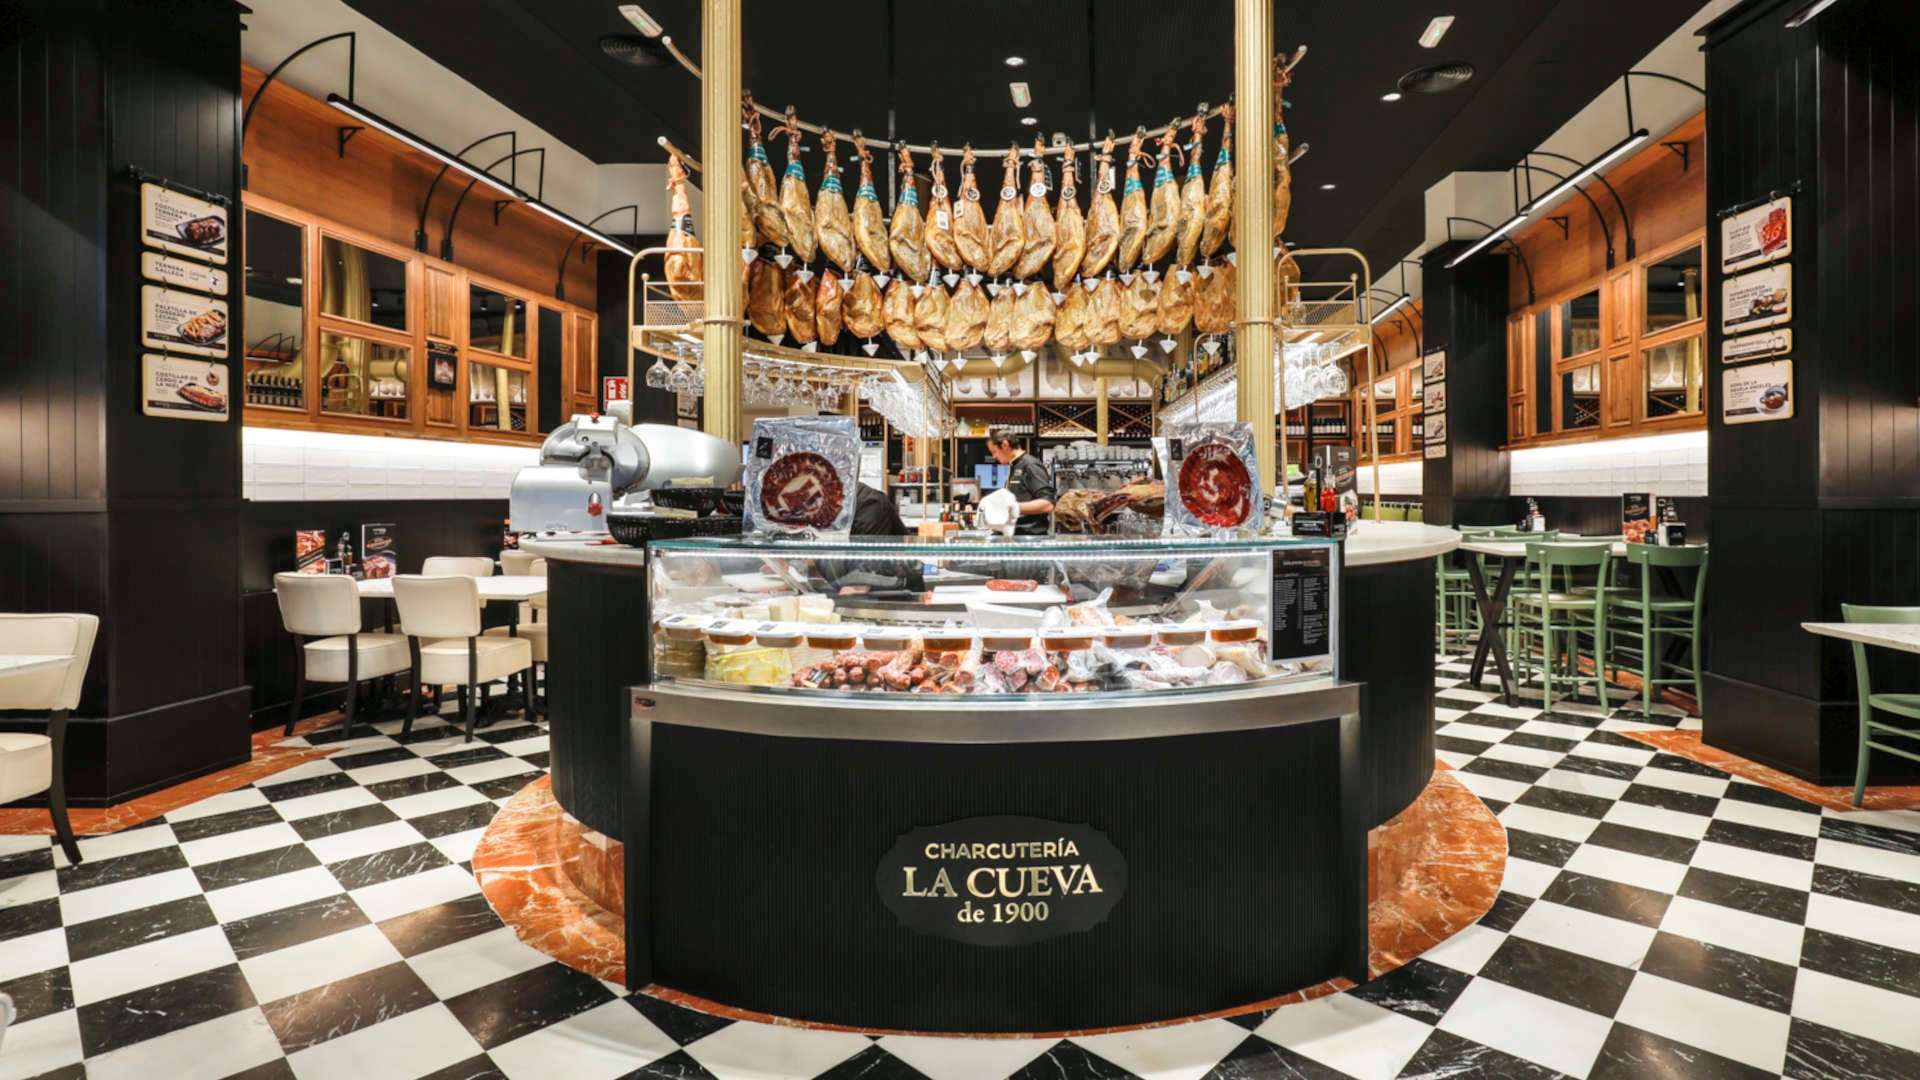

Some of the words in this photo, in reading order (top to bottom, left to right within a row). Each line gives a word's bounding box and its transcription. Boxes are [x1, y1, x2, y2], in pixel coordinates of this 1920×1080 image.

[155, 261, 184, 272] TERNERA
[925, 838, 1080, 860] CHARCUTERÍA
[902, 866, 958, 898] LA
[966, 864, 1104, 898] CUEVA
[957, 901, 985, 923] de
[993, 901, 1049, 924] 1900
